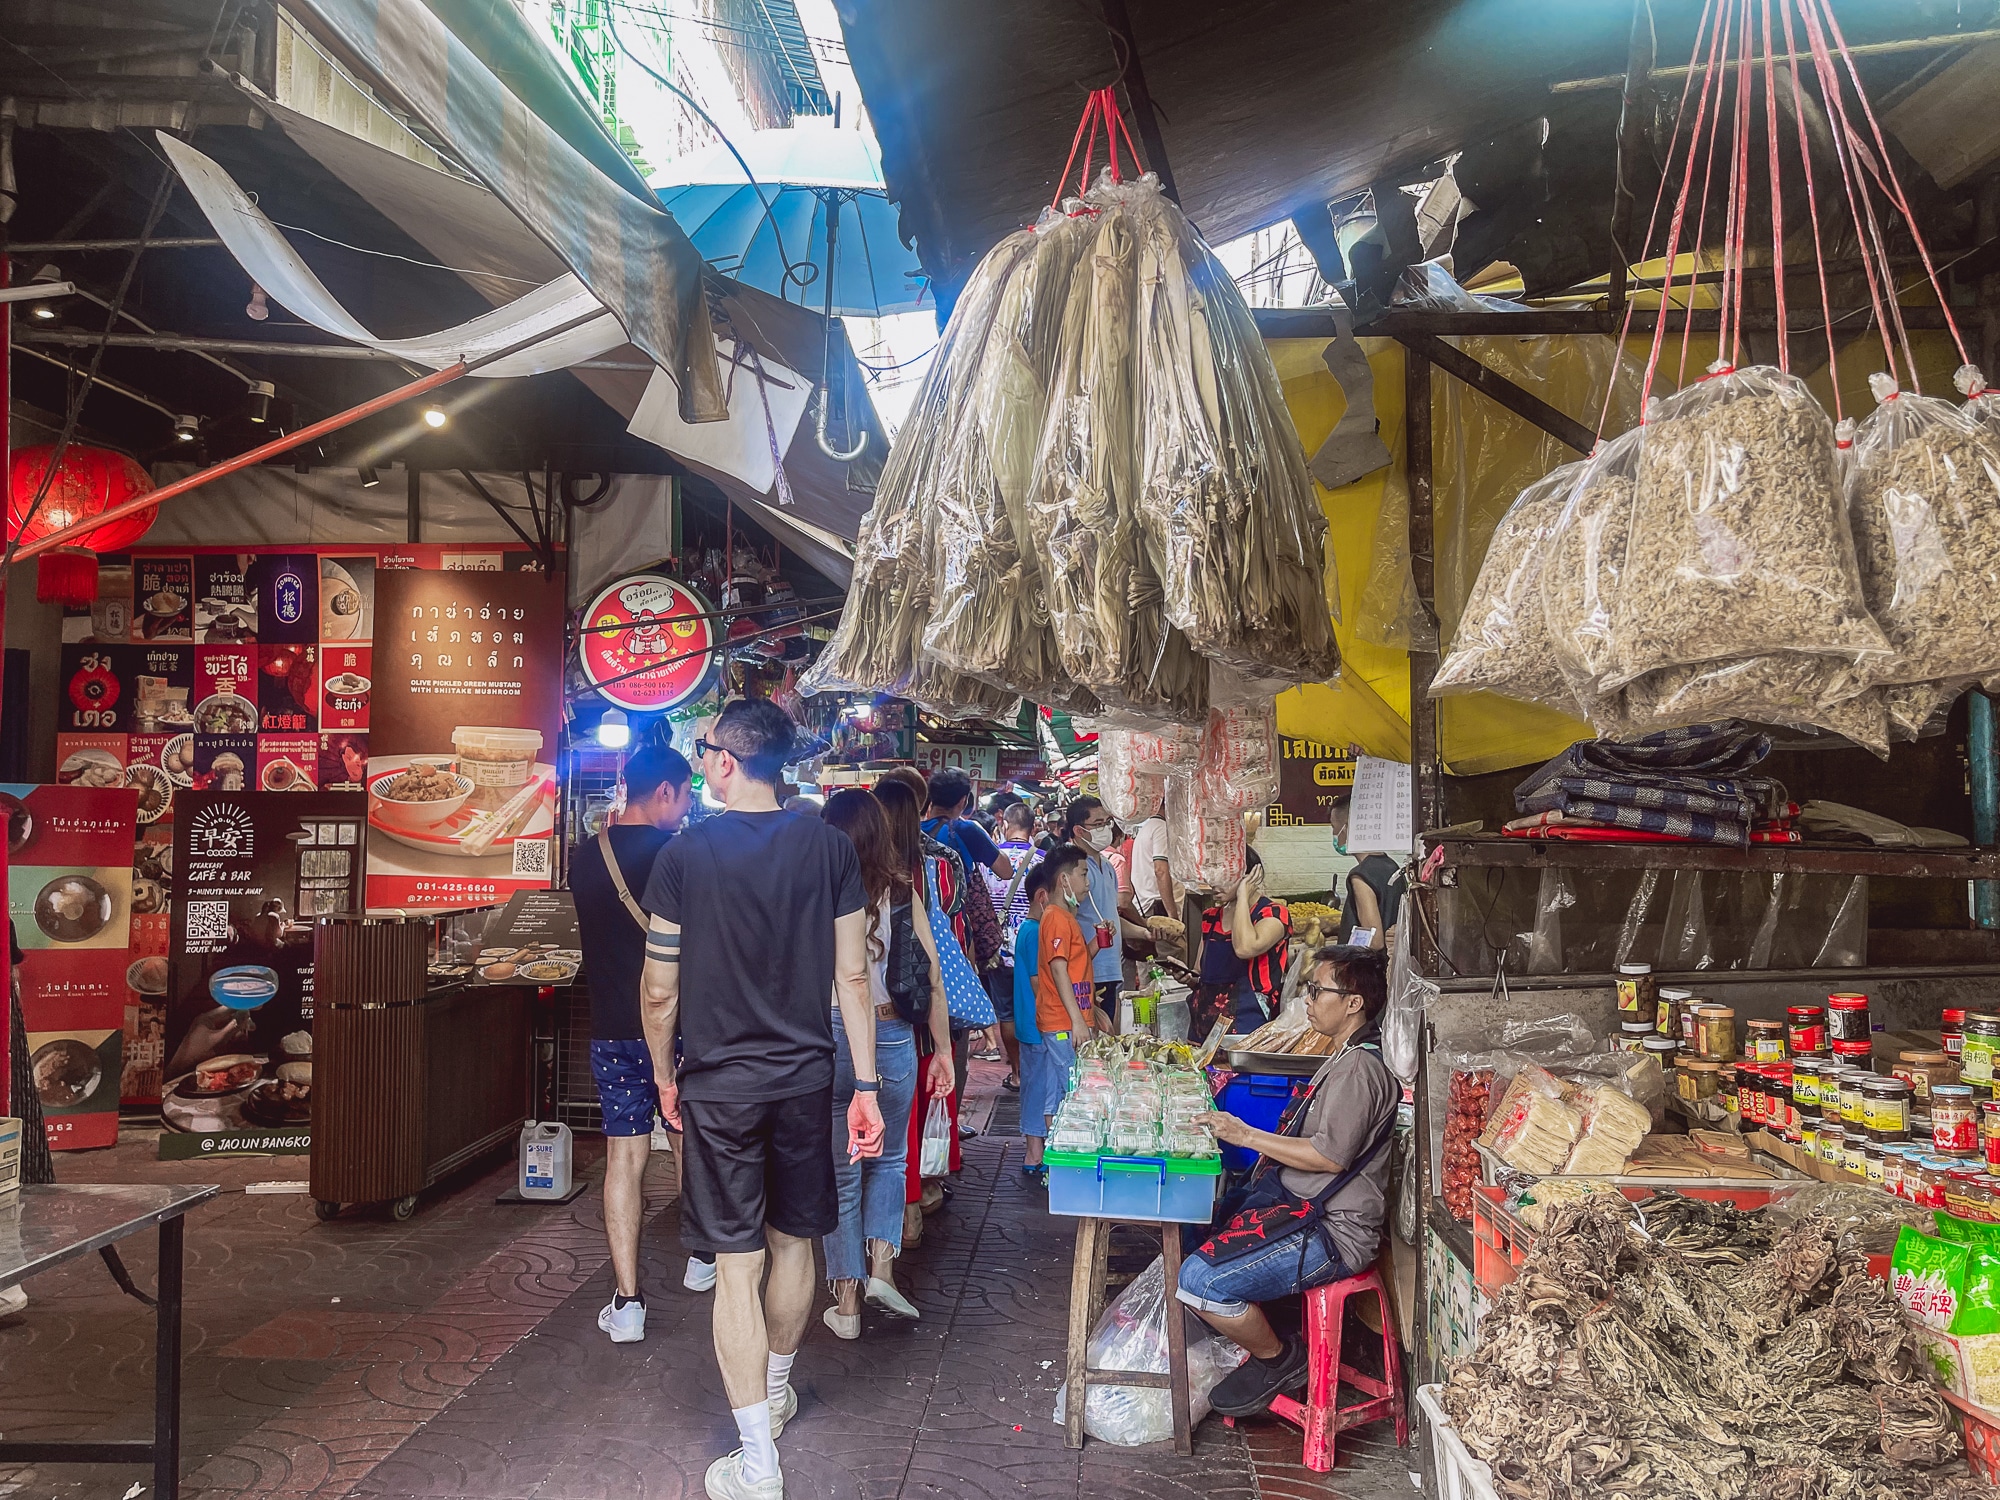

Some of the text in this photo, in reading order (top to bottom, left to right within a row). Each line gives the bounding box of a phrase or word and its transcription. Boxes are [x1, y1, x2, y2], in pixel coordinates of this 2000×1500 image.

[143, 574, 160, 591] 脆
[209, 571, 244, 583] ชาร้อน
[626, 587, 659, 602] อร่อย..
[412, 601, 525, 620] กาน่าฉ่าย
[411, 625, 524, 644] เห็ดหอม
[205, 655, 248, 676] พะโล้
[344, 653, 356, 667] 脆
[410, 650, 524, 671] คุณเล็ก
[215, 677, 236, 699] 香
[410, 679, 431, 687] OLIVE
[463, 680, 487, 688] GREEN
[434, 687, 472, 695] SHIITAKE
[474, 688, 521, 696] MUSHROOM
[262, 714, 306, 730] 紅燈籠
[968, 746, 986, 761] ถูก
[969, 763, 982, 778] ดี
[210, 817, 236, 827] JAO.UN
[201, 827, 243, 849] 早安
[188, 868, 251, 881] CAFÉ & BAR
[245, 887, 263, 895] AWAY
[416, 882, 495, 893] 081-425-6640
[186, 945, 227, 954] ROUTE MAP
[201, 1136, 311, 1151] @ JAO.UN.BANGKO
